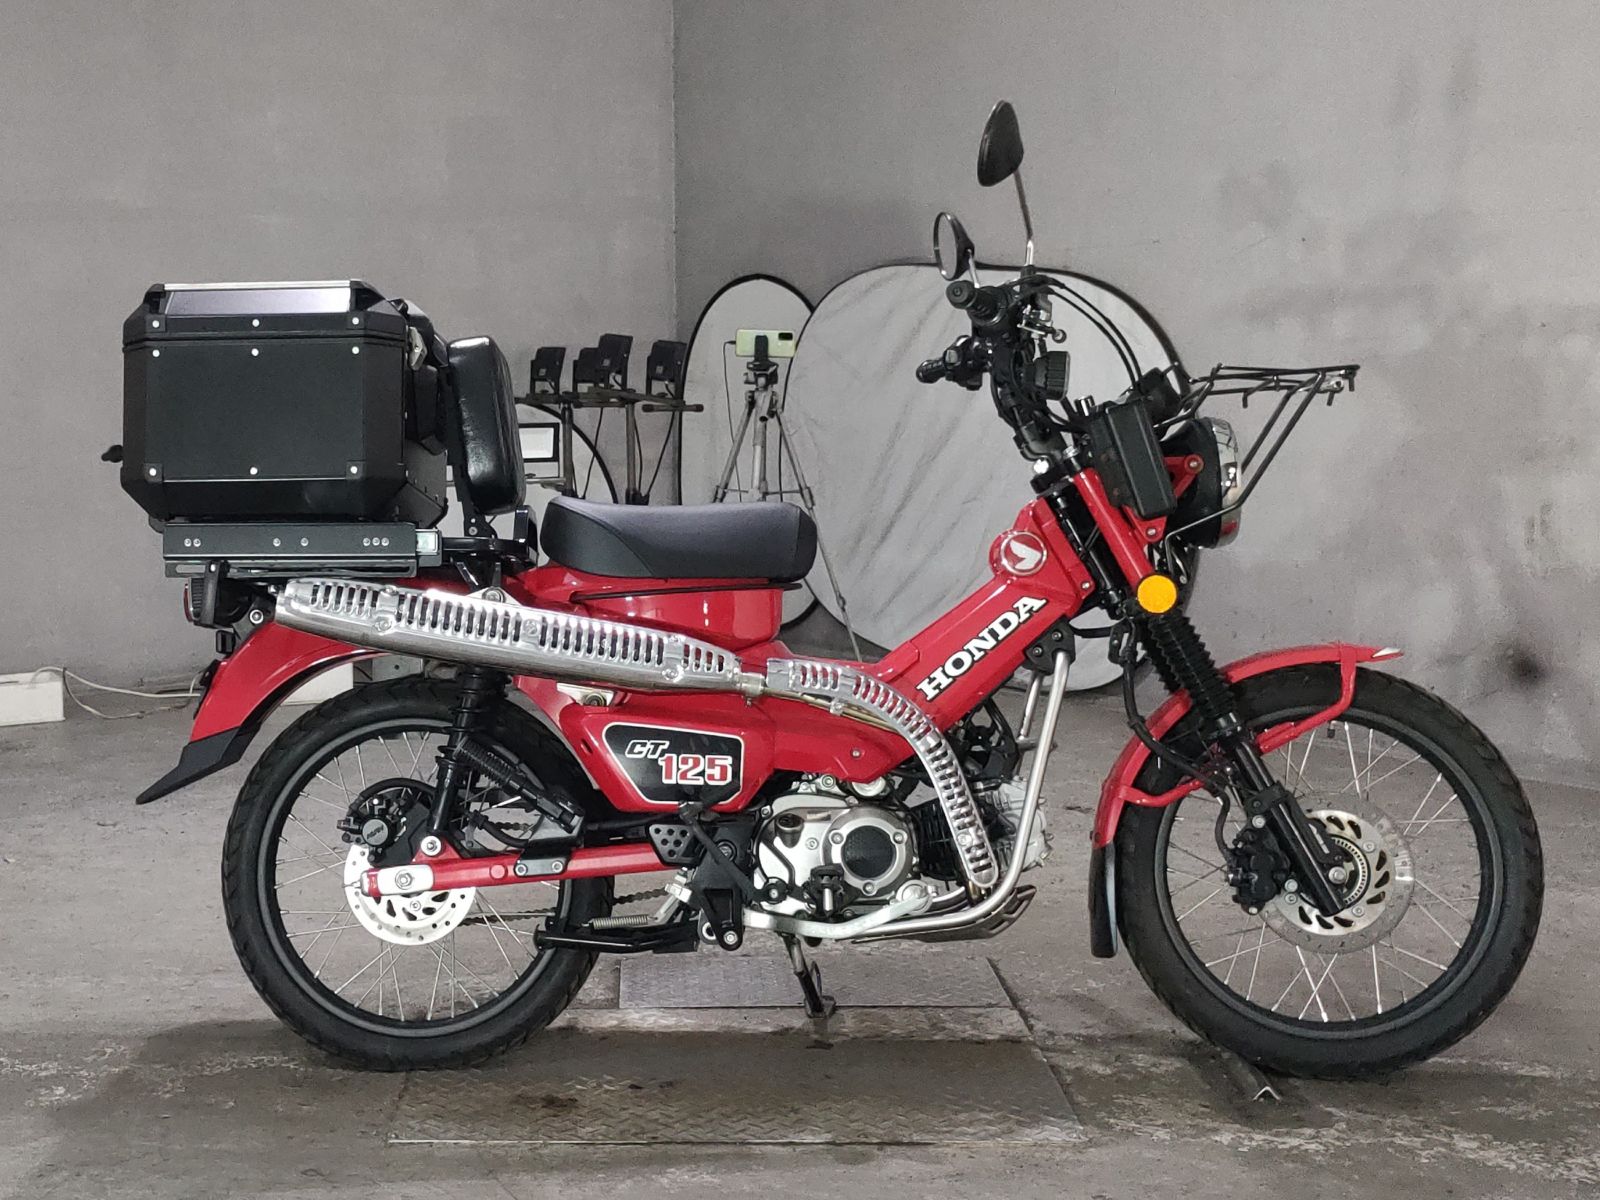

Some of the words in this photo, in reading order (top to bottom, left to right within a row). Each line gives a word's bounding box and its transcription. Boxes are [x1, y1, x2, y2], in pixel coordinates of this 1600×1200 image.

[917, 596, 1047, 700] HONDA
[625, 740, 670, 759] CT
[658, 753, 732, 785] 125
